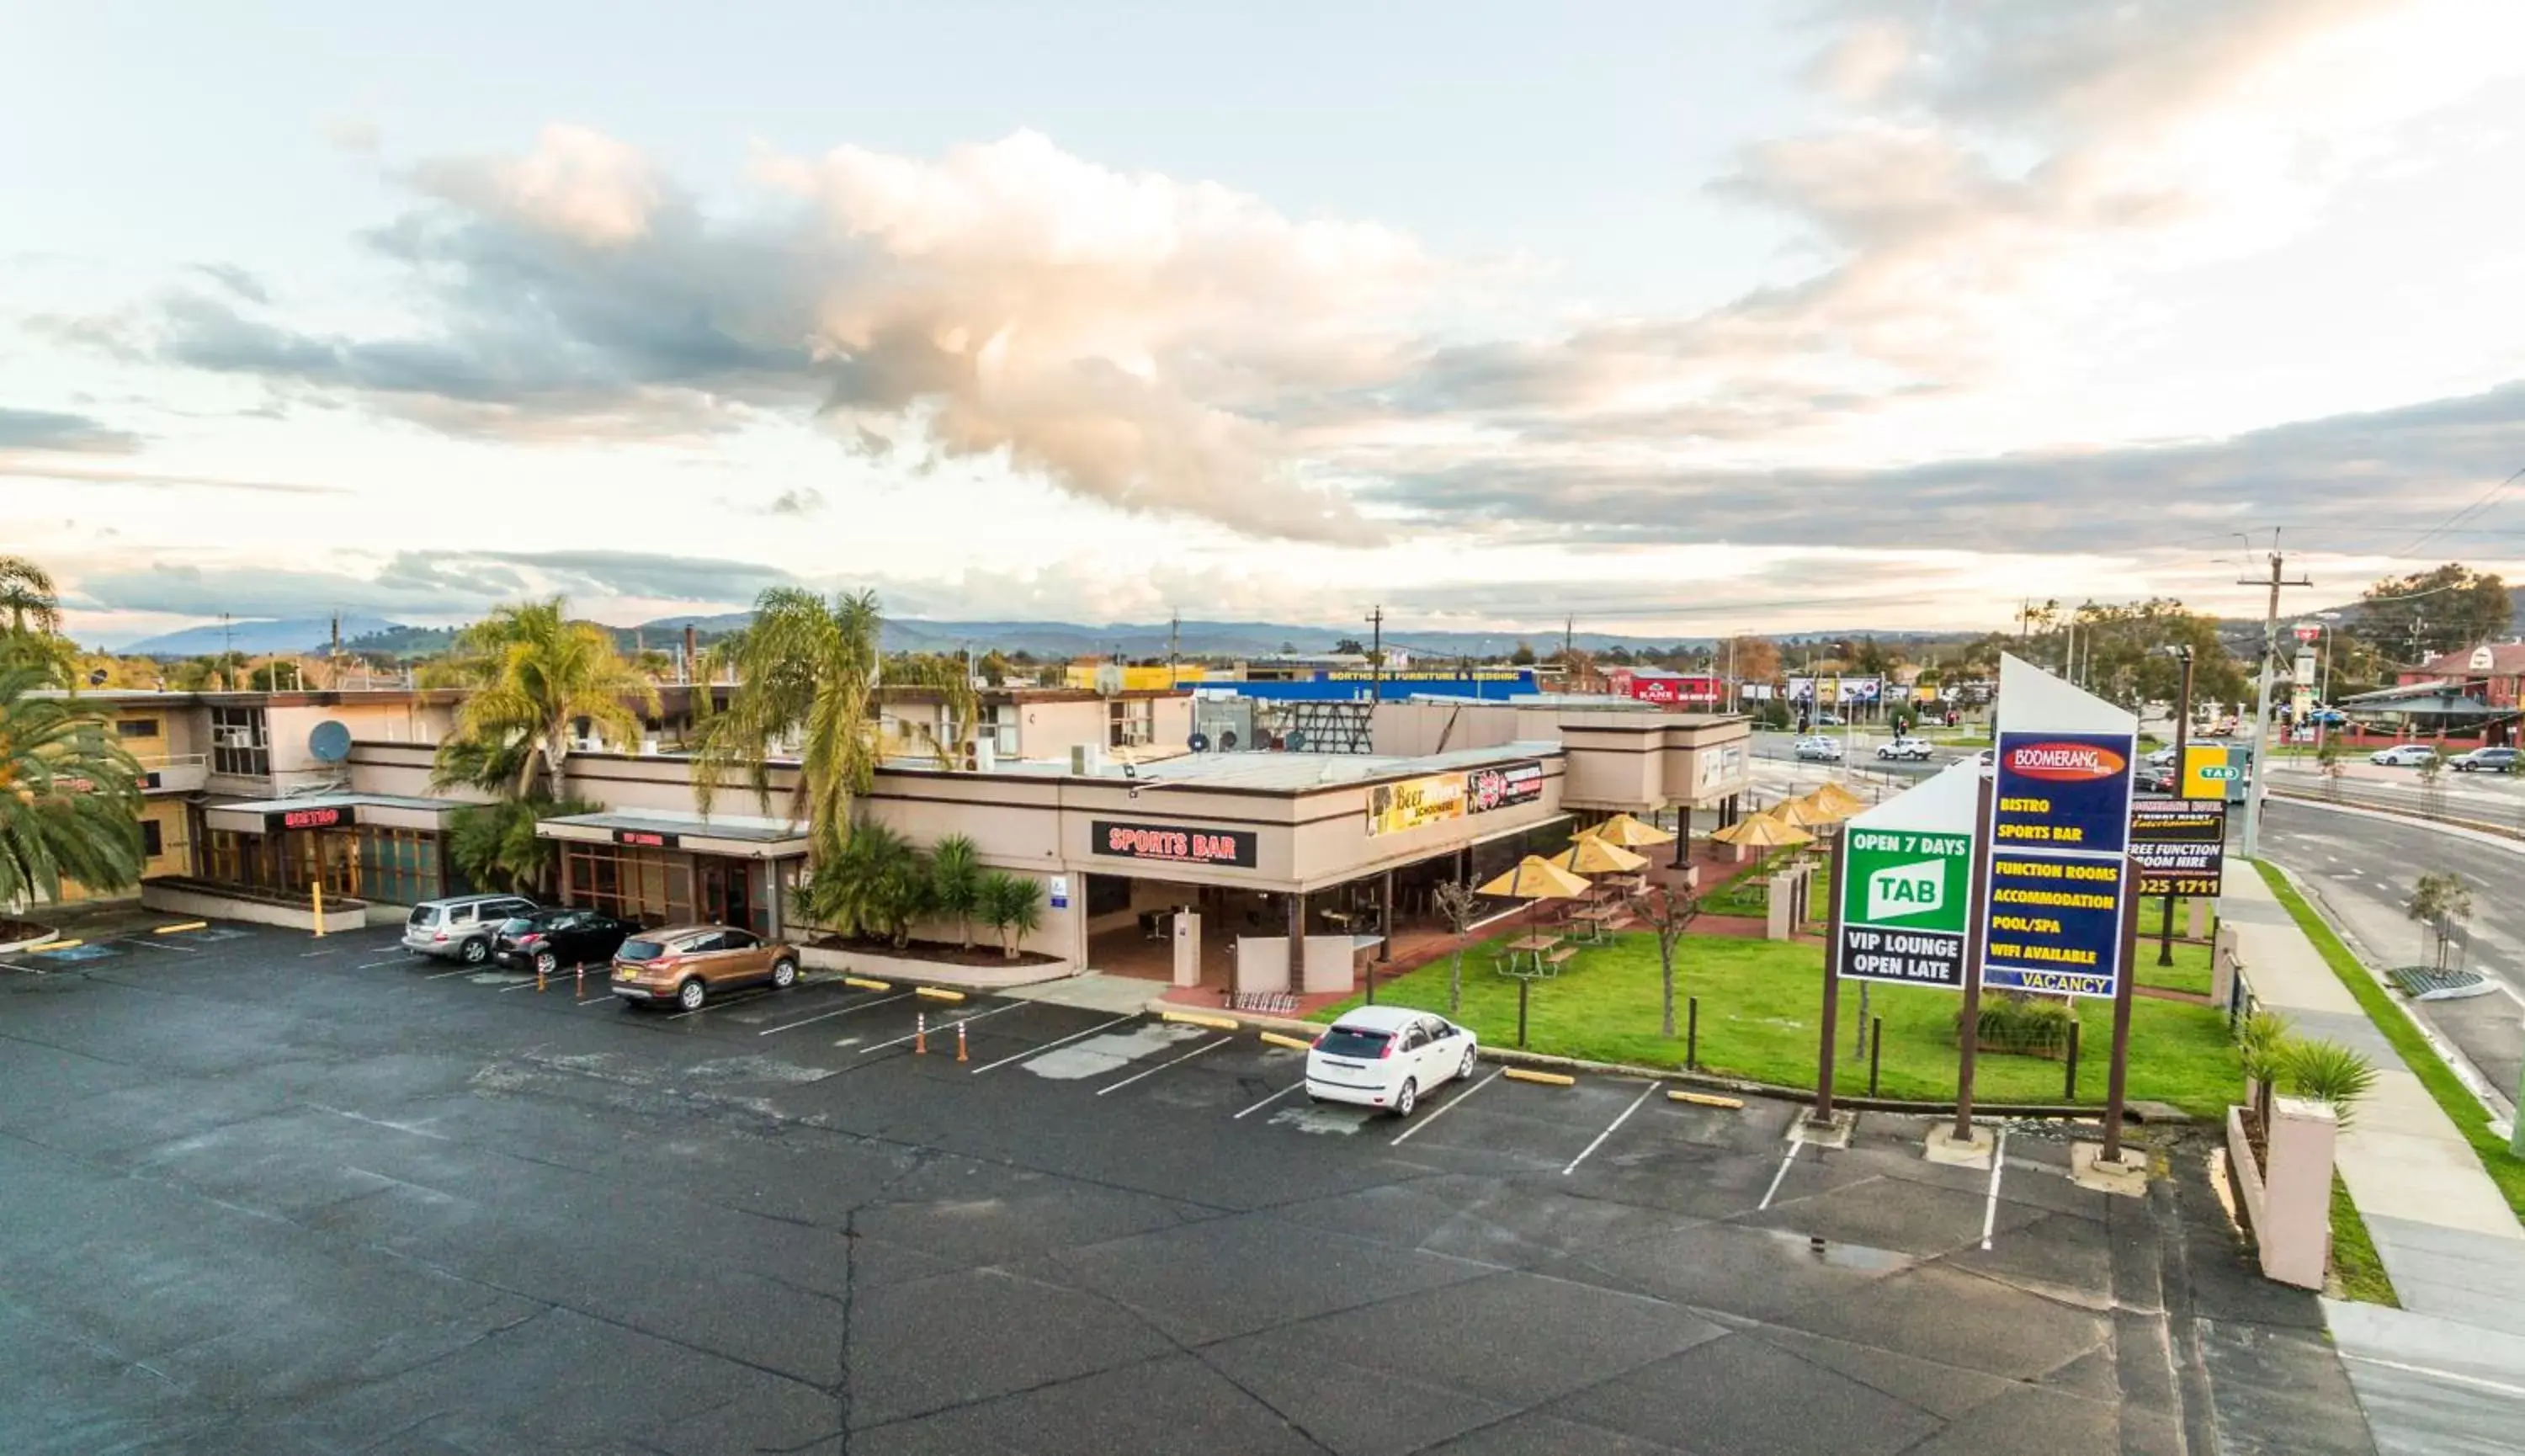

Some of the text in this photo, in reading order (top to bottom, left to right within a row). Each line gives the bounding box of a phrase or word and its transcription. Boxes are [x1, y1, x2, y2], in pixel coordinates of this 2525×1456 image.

[2014, 749, 2098, 770] BOOMERANG
[2204, 768, 2234, 777] TAB
[1395, 784, 1425, 811] Beer
[1999, 798, 2050, 812] BISTRO
[1997, 824, 2083, 841] SPORTS BAR
[1109, 828, 1187, 856] SPORTS
[1193, 834, 1236, 859] BAR
[1853, 833, 1966, 856] OPEN 7 DAYS
[2156, 844, 2221, 856] FUNCTION
[1995, 861, 2118, 882] FUNCTION ROOMS
[2177, 857, 2208, 868] HIRE
[1877, 877, 1936, 904] TAB
[2175, 879, 2219, 894] 1711
[1993, 889, 2115, 910] ACCOMMODATION
[1992, 916, 2061, 933] POOL/SPA
[1848, 932, 1959, 958] VIP LOUNGE
[1990, 943, 2097, 965] WIFI AVAILABLE
[1853, 954, 1951, 980] OPEN LATE
[2022, 972, 2108, 992] VACANCY
